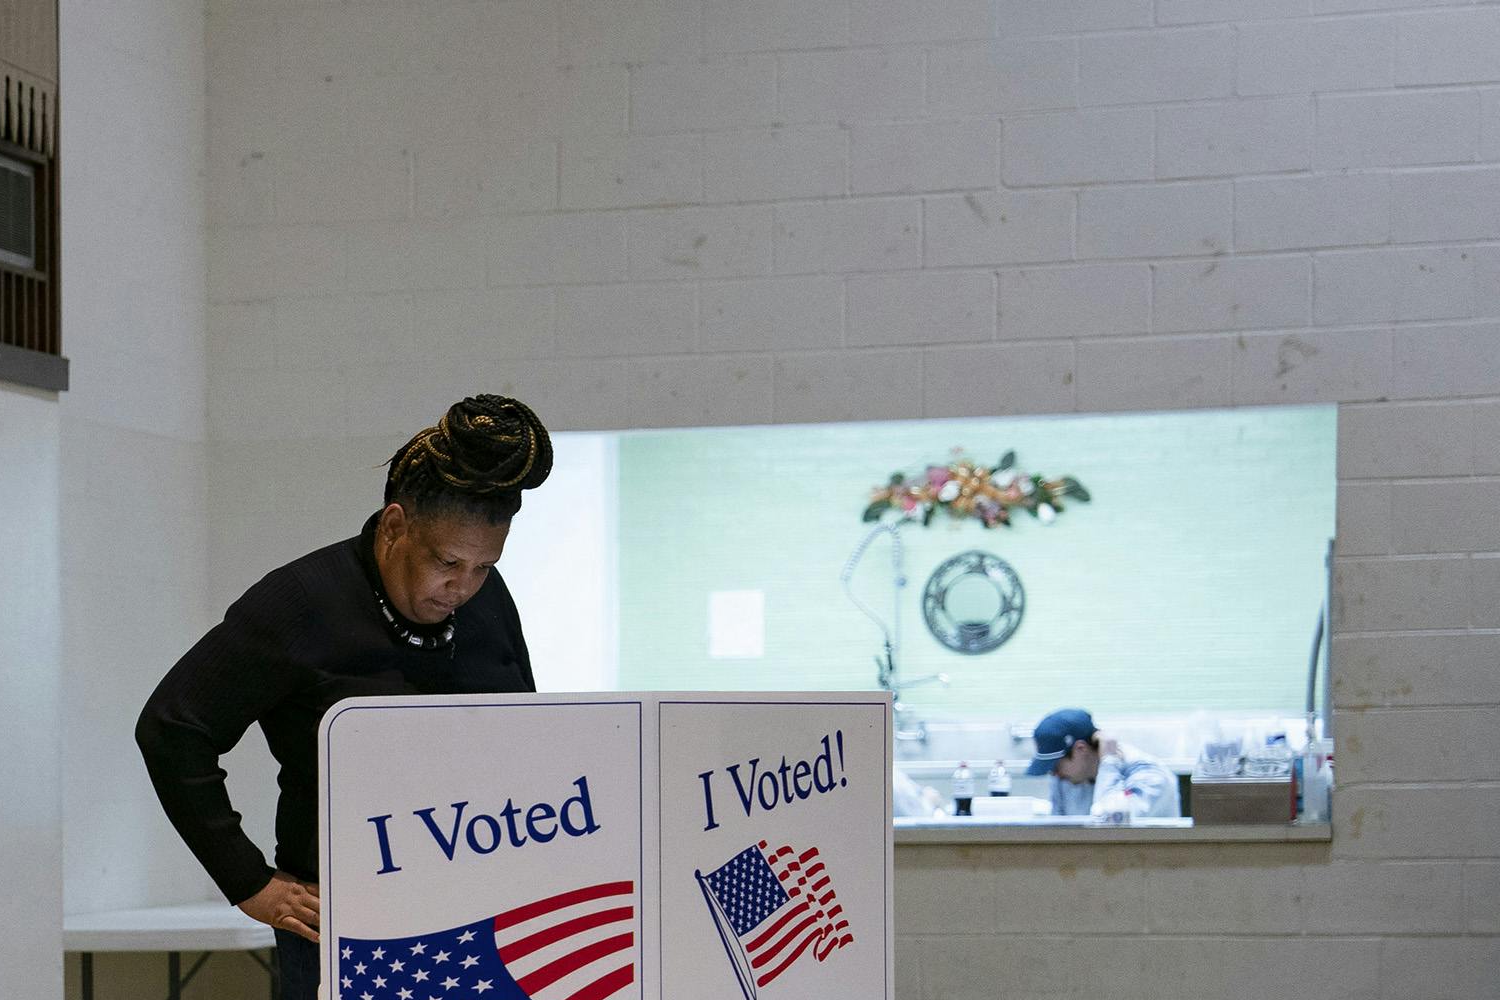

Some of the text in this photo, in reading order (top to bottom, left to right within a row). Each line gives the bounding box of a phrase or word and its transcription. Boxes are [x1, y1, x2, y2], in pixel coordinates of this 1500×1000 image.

[367, 775, 601, 875] I Voted
[698, 729, 848, 832] I Voted!
